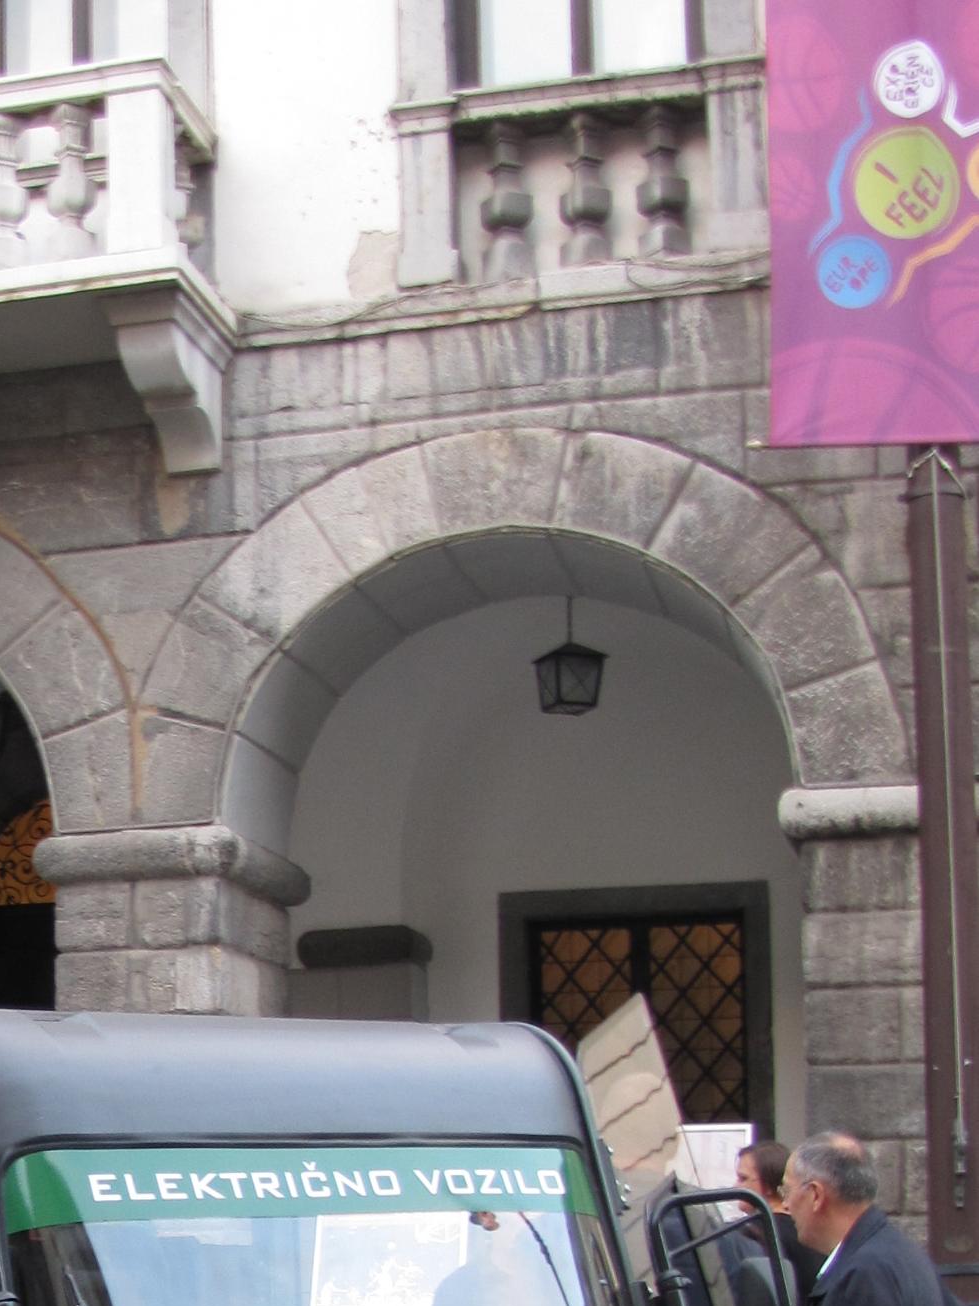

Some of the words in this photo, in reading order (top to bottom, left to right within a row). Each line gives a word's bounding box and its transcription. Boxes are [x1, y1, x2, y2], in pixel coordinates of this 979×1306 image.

[875, 162, 898, 184] I
[884, 167, 944, 229] FEEL
[87, 1162, 402, 1202] ELEKTRIČNO
[413, 1168, 566, 1196] VOZILO
